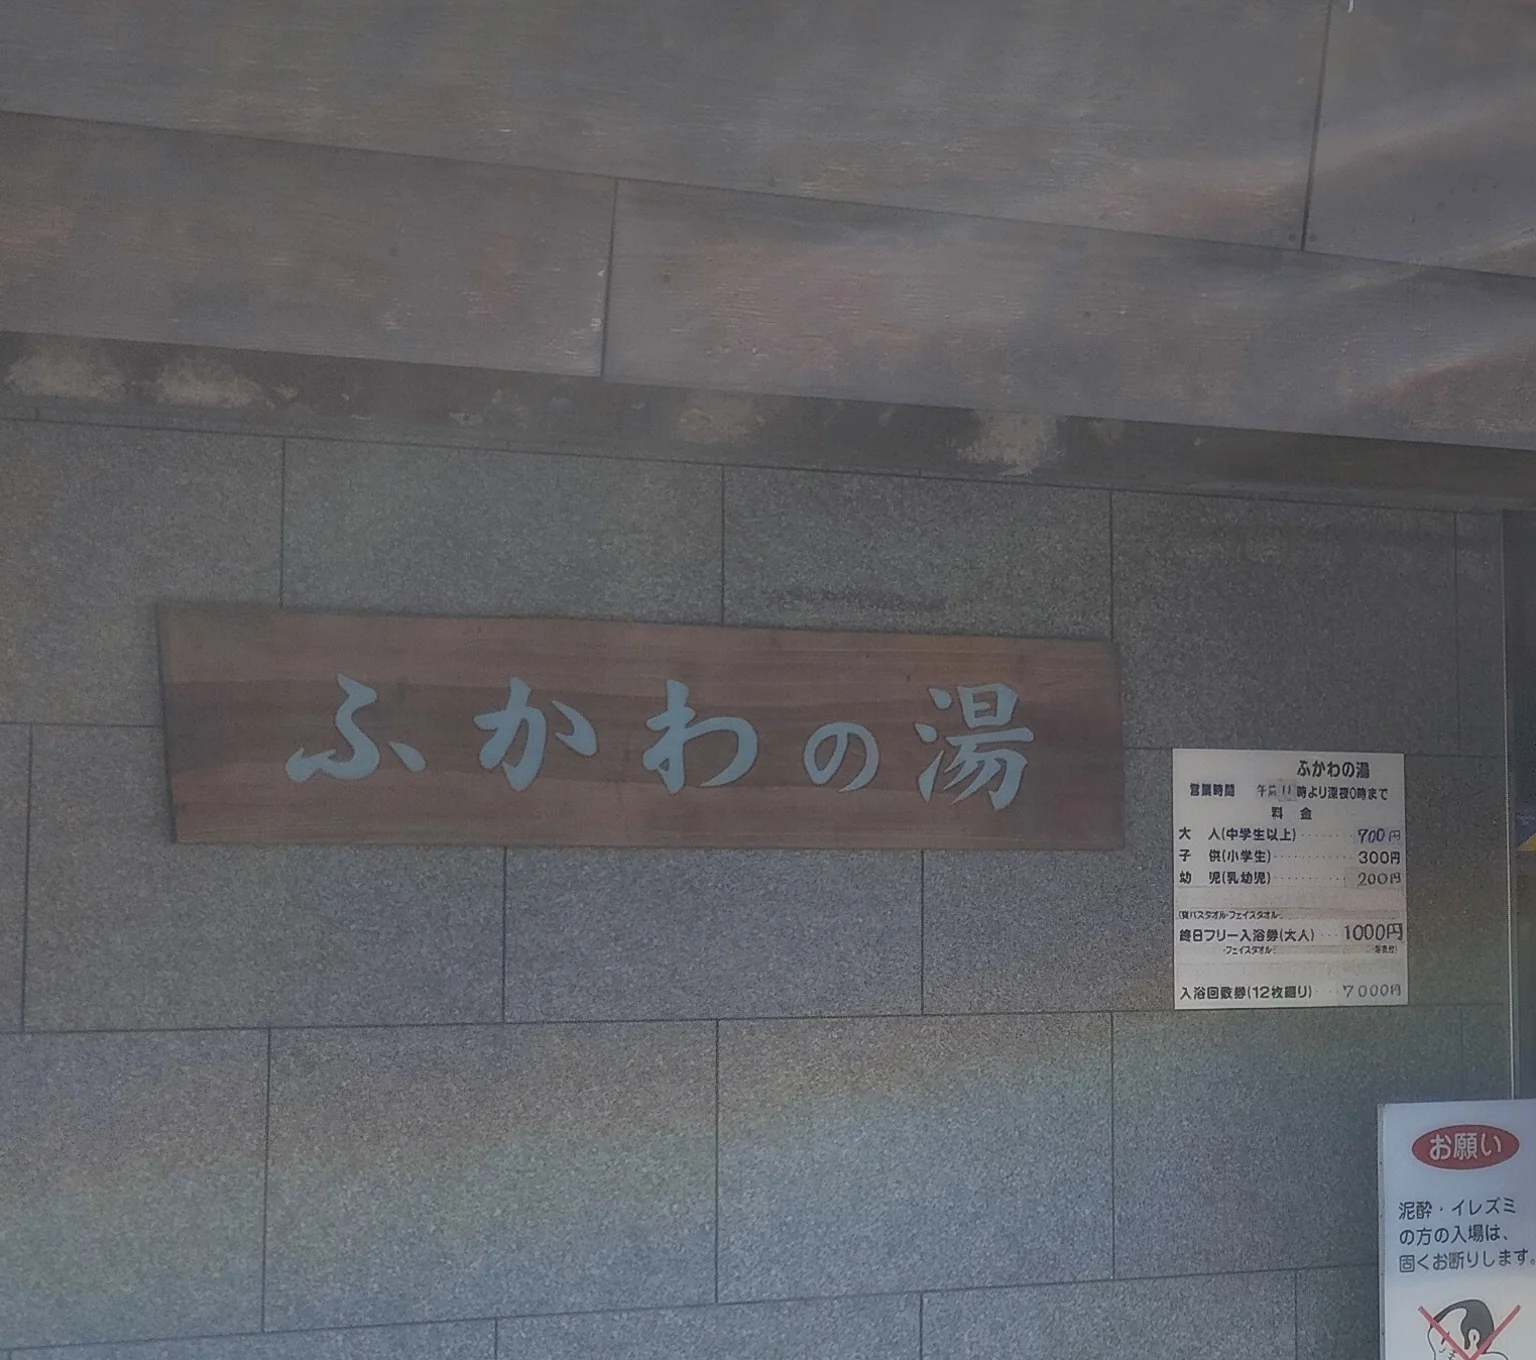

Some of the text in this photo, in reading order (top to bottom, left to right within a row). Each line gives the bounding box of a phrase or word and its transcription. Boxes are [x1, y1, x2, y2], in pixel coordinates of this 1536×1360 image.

[285, 672, 1034, 812] ふかわの湯
[1297, 760, 1370, 779] ふかわの湯
[1189, 783, 1236, 798] 営業時間
[1357, 827, 1401, 845] 700円
[1358, 850, 1401, 865] 300円
[1357, 871, 1402, 888] 200円
[1344, 922, 1404, 942] 1000円
[1428, 1125, 1503, 1161] お願い
[1398, 1197, 1517, 1221] 泥酔・イレズミ
[1399, 1223, 1509, 1246] の方の入場は、
[1398, 1247, 1536, 1273] 固くお断りします。
